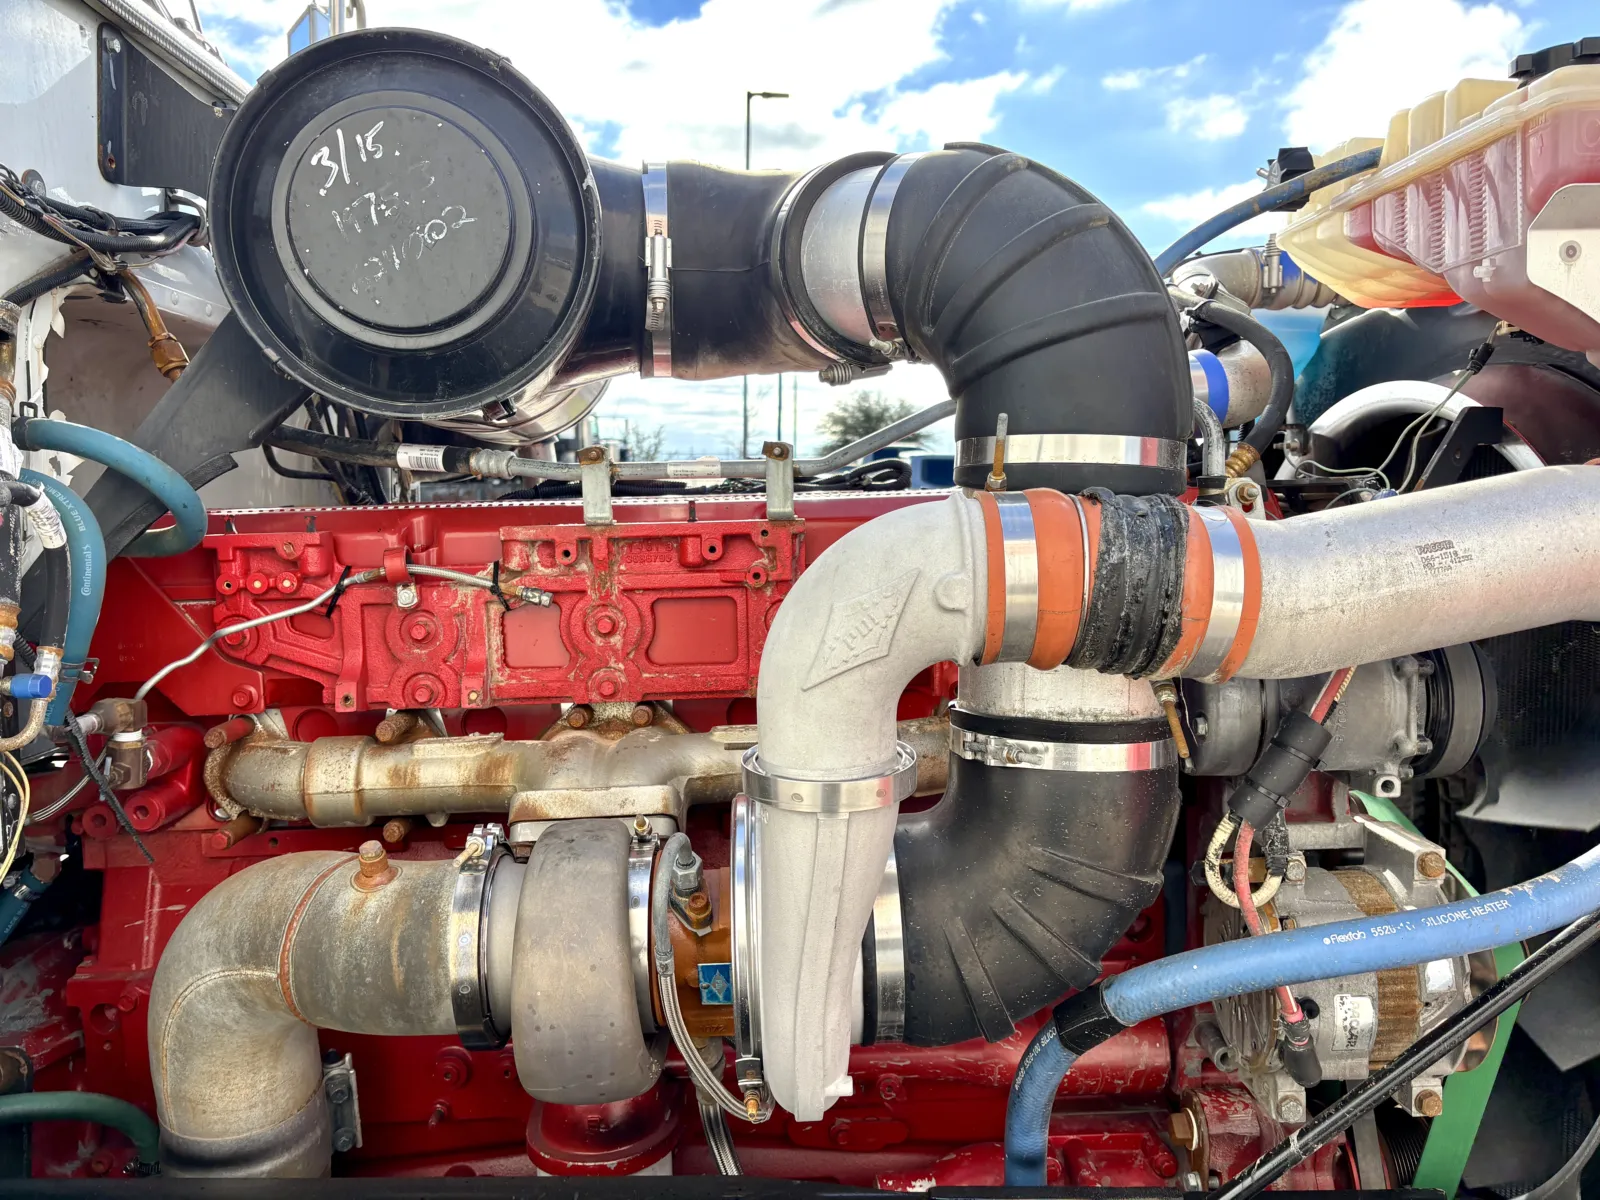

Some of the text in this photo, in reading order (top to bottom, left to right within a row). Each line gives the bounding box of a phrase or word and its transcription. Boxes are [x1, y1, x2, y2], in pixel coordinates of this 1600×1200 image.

[70, 510, 87, 532] BLUE
[1415, 540, 1455, 556] PACCAR
[81, 551, 92, 596] Continental
[1330, 930, 1367, 944] Flexfab
[1421, 910, 1471, 928] SILICONE
[1471, 899, 1512, 917] HEATER
